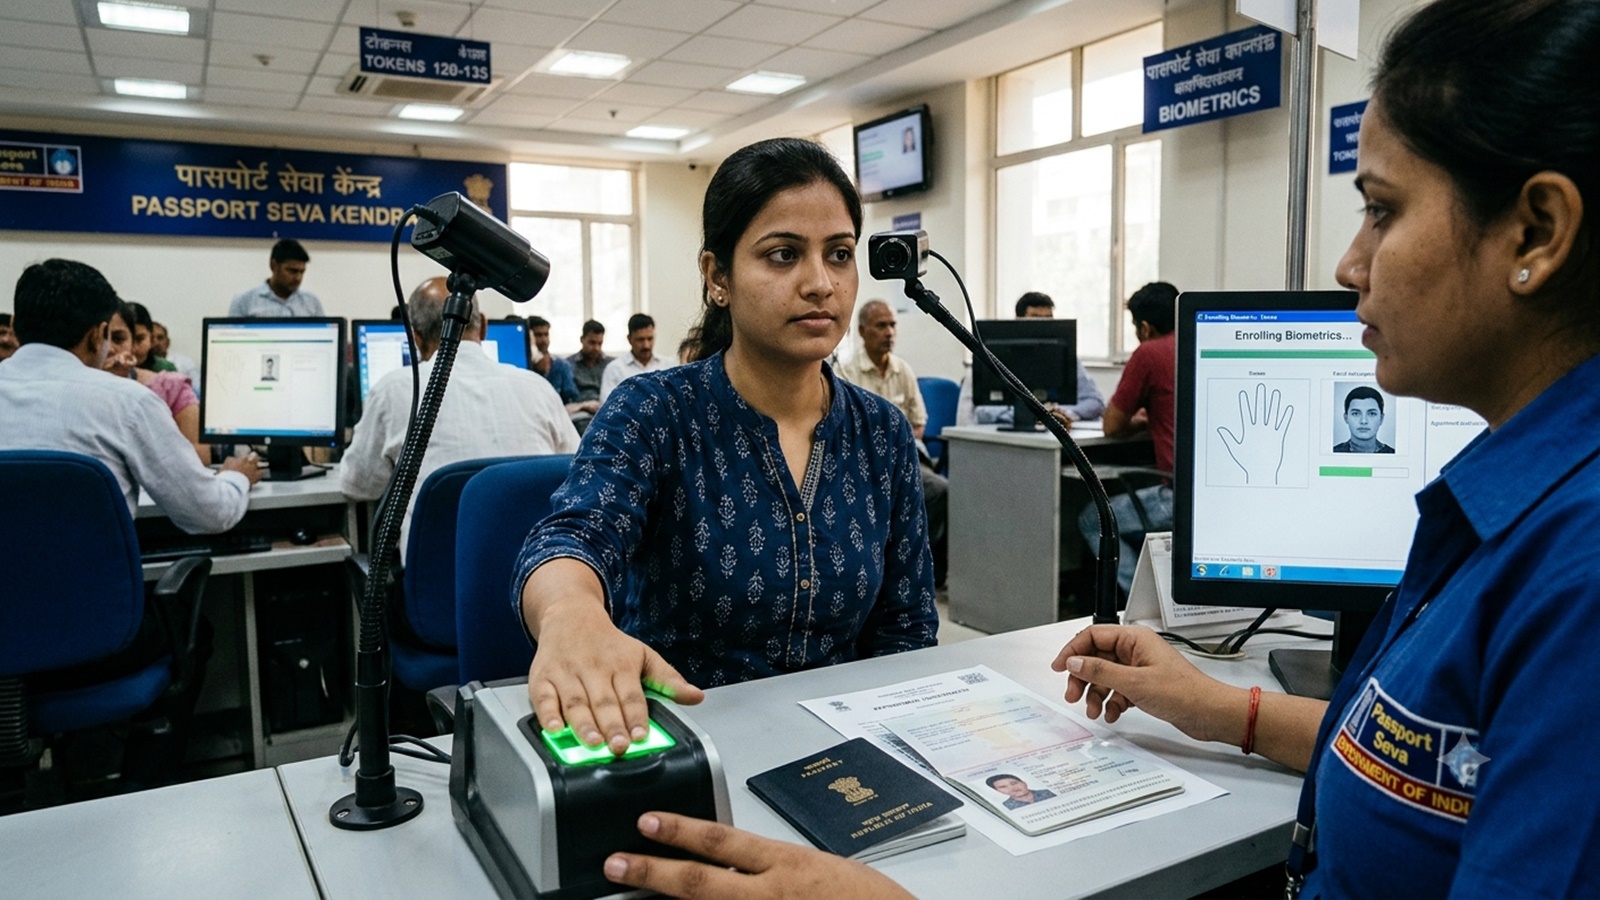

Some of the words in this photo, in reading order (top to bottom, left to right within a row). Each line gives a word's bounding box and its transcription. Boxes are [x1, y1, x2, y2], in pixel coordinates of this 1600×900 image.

[364, 54, 426, 73] TOKENS
[1158, 85, 1261, 124] BIOMETRICS
[174, 160, 269, 191] पासपोर्ट
[277, 163, 324, 193] सेवा
[131, 195, 260, 220] PASSPORT
[266, 202, 326, 223] SEVA
[1235, 330, 1282, 342] Enrolling
[1285, 330, 1352, 341] Biometrics...
[1370, 702, 1433, 751] Passport
[1373, 730, 1409, 766] Seva
[1402, 782, 1427, 800] OF
[1431, 791, 1470, 815] INDI
